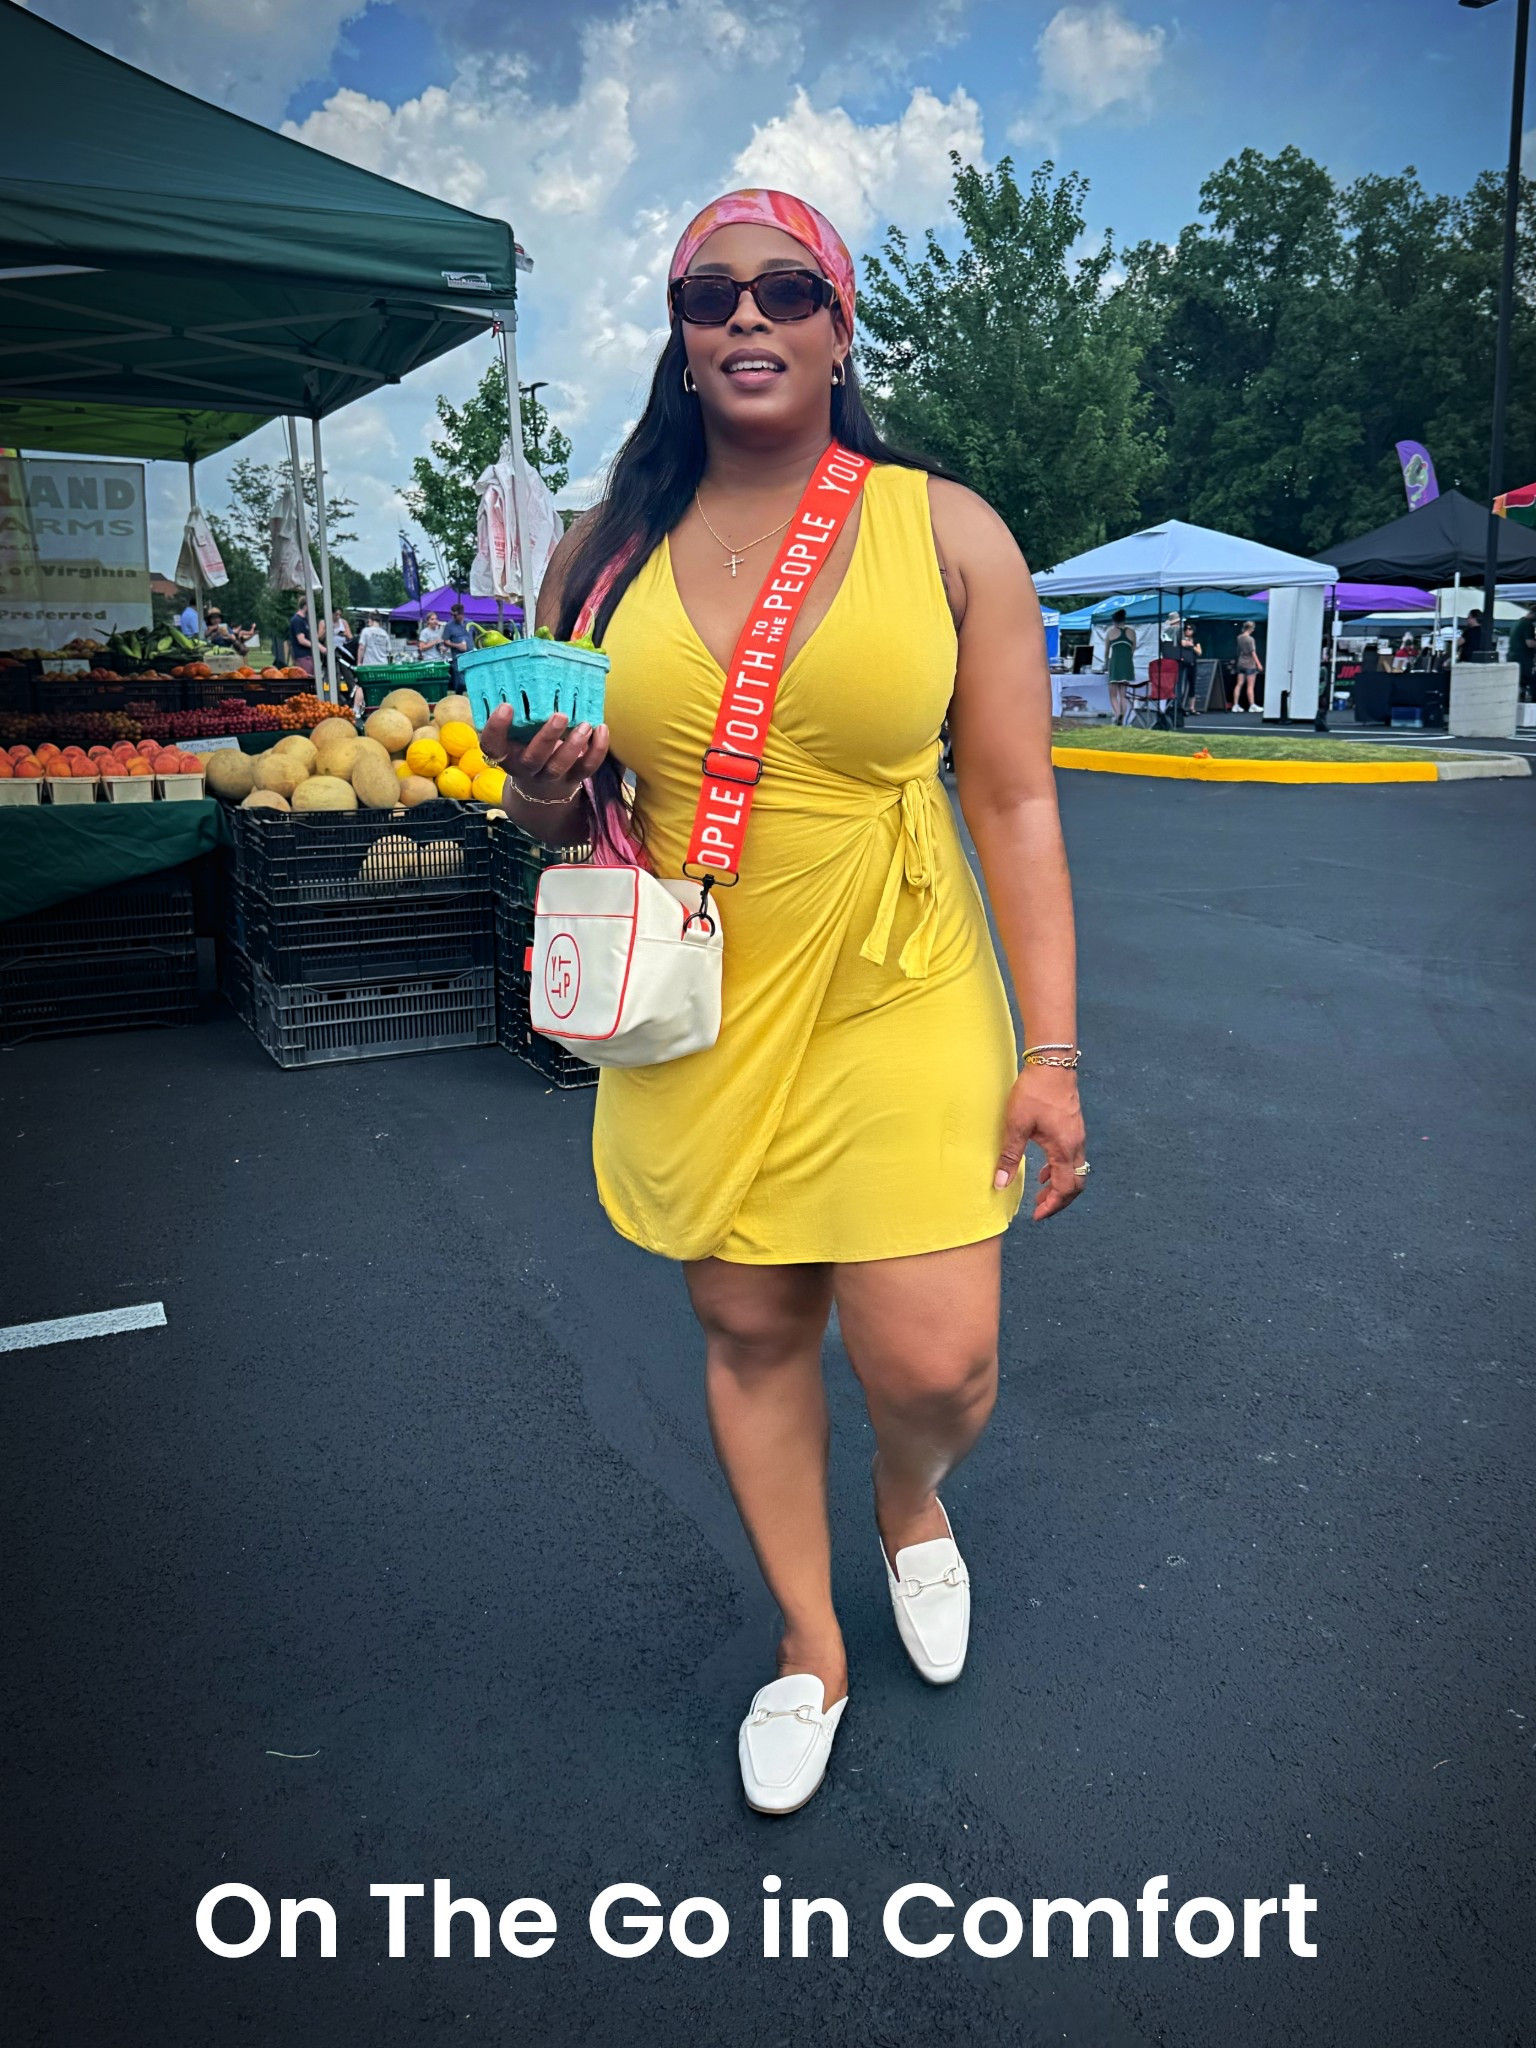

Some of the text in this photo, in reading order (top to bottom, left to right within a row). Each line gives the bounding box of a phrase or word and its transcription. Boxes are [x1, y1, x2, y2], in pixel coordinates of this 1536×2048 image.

[818, 448, 865, 494] YOU
[0, 516, 135, 536] ARMS
[9, 565, 137, 579] of Virginia
[763, 512, 836, 610] PEOPLE
[0, 609, 107, 620] Preferred
[752, 620, 769, 636] TO
[767, 617, 787, 643] THE
[697, 786, 745, 869] OPLE
